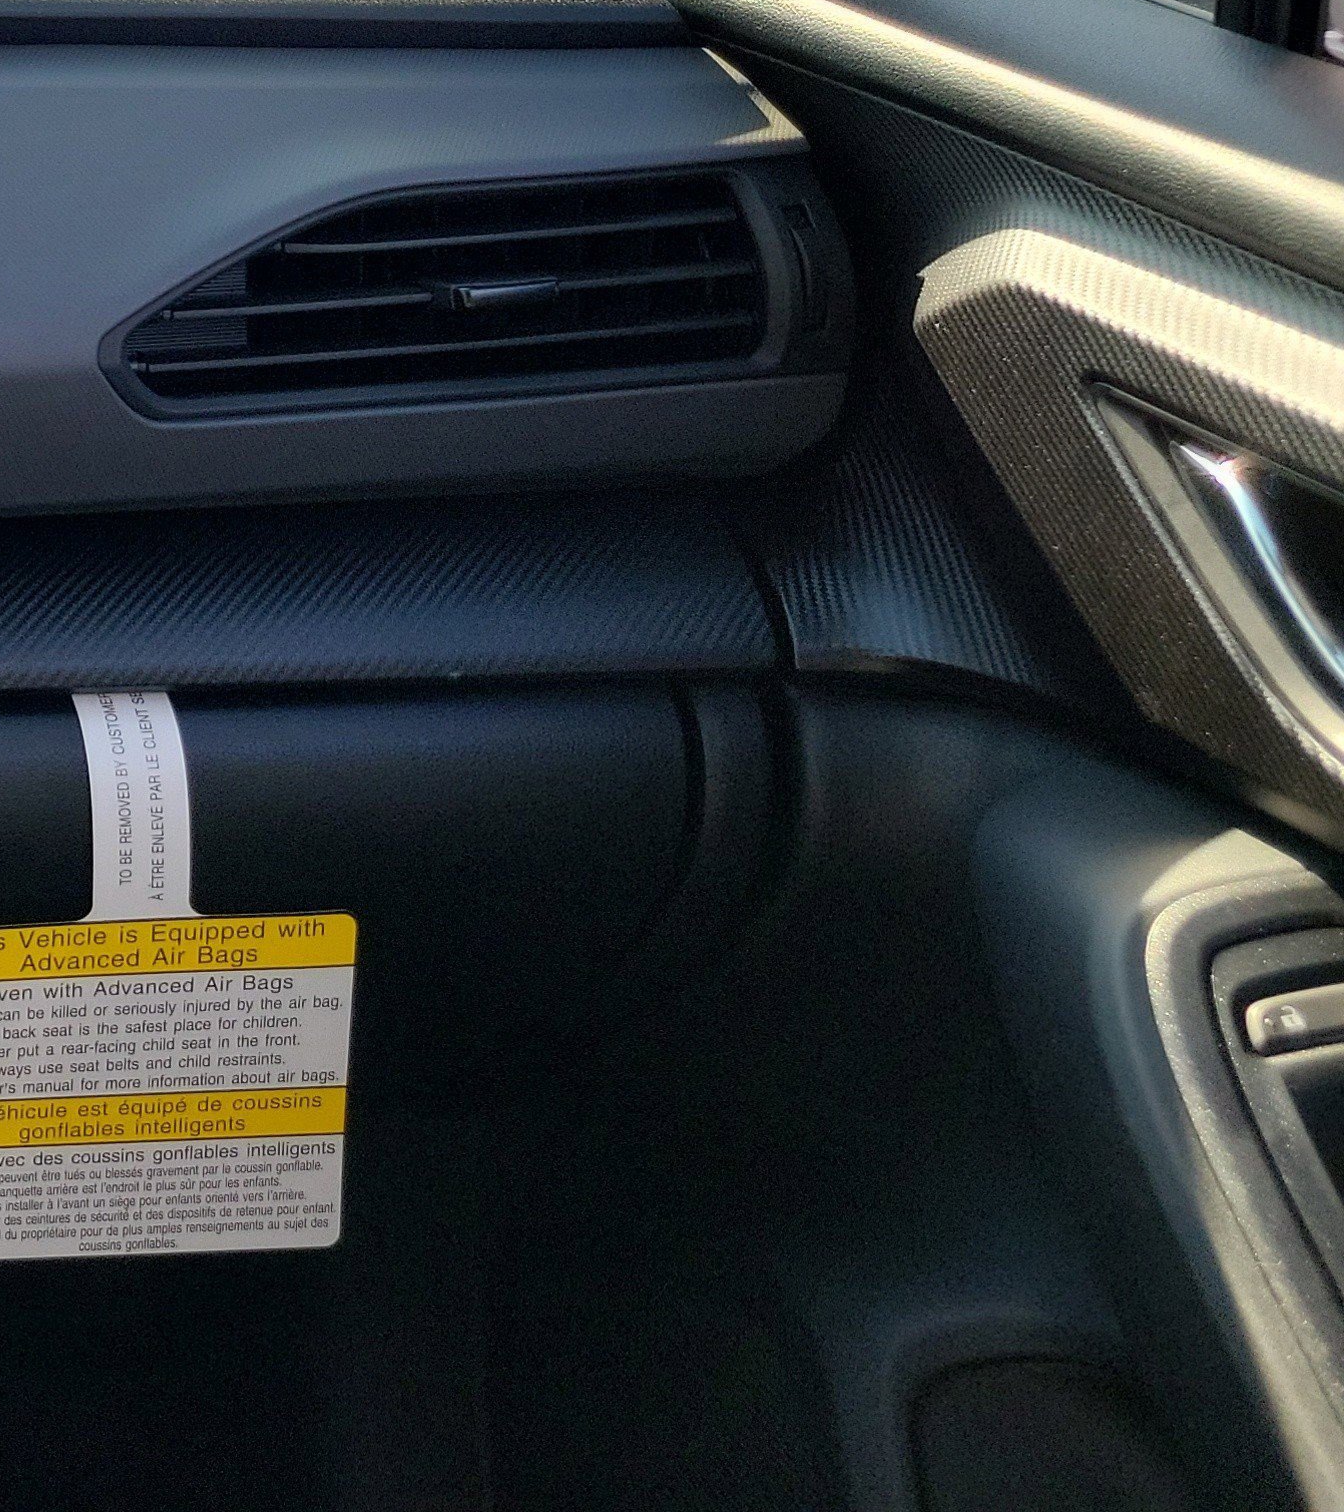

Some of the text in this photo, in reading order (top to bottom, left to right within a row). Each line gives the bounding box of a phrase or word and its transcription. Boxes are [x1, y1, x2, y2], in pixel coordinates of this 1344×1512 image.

[134, 708, 157, 749] CLIENT
[113, 759, 129, 777] BY
[145, 754, 160, 770] LE
[148, 774, 164, 801] PAR
[116, 781, 133, 844] REMOVED
[119, 849, 133, 865] BE
[118, 869, 133, 887] TO
[18, 929, 106, 948] Vehicle
[119, 926, 137, 943] is
[150, 922, 265, 944] Equipped
[278, 919, 324, 937] with
[19, 946, 257, 971] Advanced Air Bags
[42, 982, 82, 998] with
[92, 978, 194, 996] Advanced
[204, 976, 233, 991] Air
[242, 975, 293, 993] Bags
[26, 1007, 44, 1020] be
[50, 1005, 87, 1018] killed
[92, 1005, 108, 1016] or
[113, 1001, 176, 1016] seriously
[182, 999, 230, 1015] injured
[236, 998, 254, 1013] by
[260, 997, 282, 1010] the
[288, 995, 307, 1009] air
[312, 995, 343, 1010] bag.
[2, 1026, 36, 1039] back
[42, 1024, 72, 1037] seat
[78, 1022, 90, 1036] is
[96, 1021, 118, 1034] the
[124, 1019, 167, 1033] safest
[172, 1018, 211, 1034] place
[218, 1016, 237, 1030] for
[242, 1015, 302, 1028] children.
[16, 1044, 39, 1060] put
[45, 1045, 54, 1056] a
[60, 1040, 136, 1055] rear-facing
[142, 1037, 174, 1051] child
[180, 1037, 211, 1049] seat
[217, 1035, 230, 1048] in
[236, 1034, 258, 1047] the
[264, 1033, 300, 1046] front.
[37, 1063, 63, 1074] use
[69, 1059, 99, 1073] seat
[105, 1057, 139, 1071] belts
[145, 1056, 172, 1069] and
[178, 1054, 210, 1068] child
[216, 1053, 285, 1066] restraints.
[22, 1078, 74, 1093] manual
[80, 1077, 99, 1090] for
[104, 1078, 141, 1089] more
[147, 1073, 224, 1087] information
[230, 1071, 270, 1084] about
[276, 1069, 296, 1083] air
[300, 1069, 338, 1084] bags.
[77, 1101, 108, 1117] est
[118, 1098, 187, 1117] équipé
[196, 1096, 222, 1112] de
[232, 1093, 322, 1110] coussins
[18, 1117, 245, 1142] gonflables intelligents
[32, 1151, 63, 1166] des
[70, 1148, 144, 1164] coussins
[152, 1144, 238, 1164] gonflables
[246, 1141, 336, 1158] intelligents
[40, 1169, 60, 1181] être
[63, 1169, 85, 1180] tués
[88, 1170, 101, 1179] ou
[104, 1167, 143, 1178] blessés
[145, 1165, 199, 1179] gravement
[201, 1165, 218, 1177] par
[221, 1163, 231, 1174] le
[234, 1163, 272, 1173] coussin
